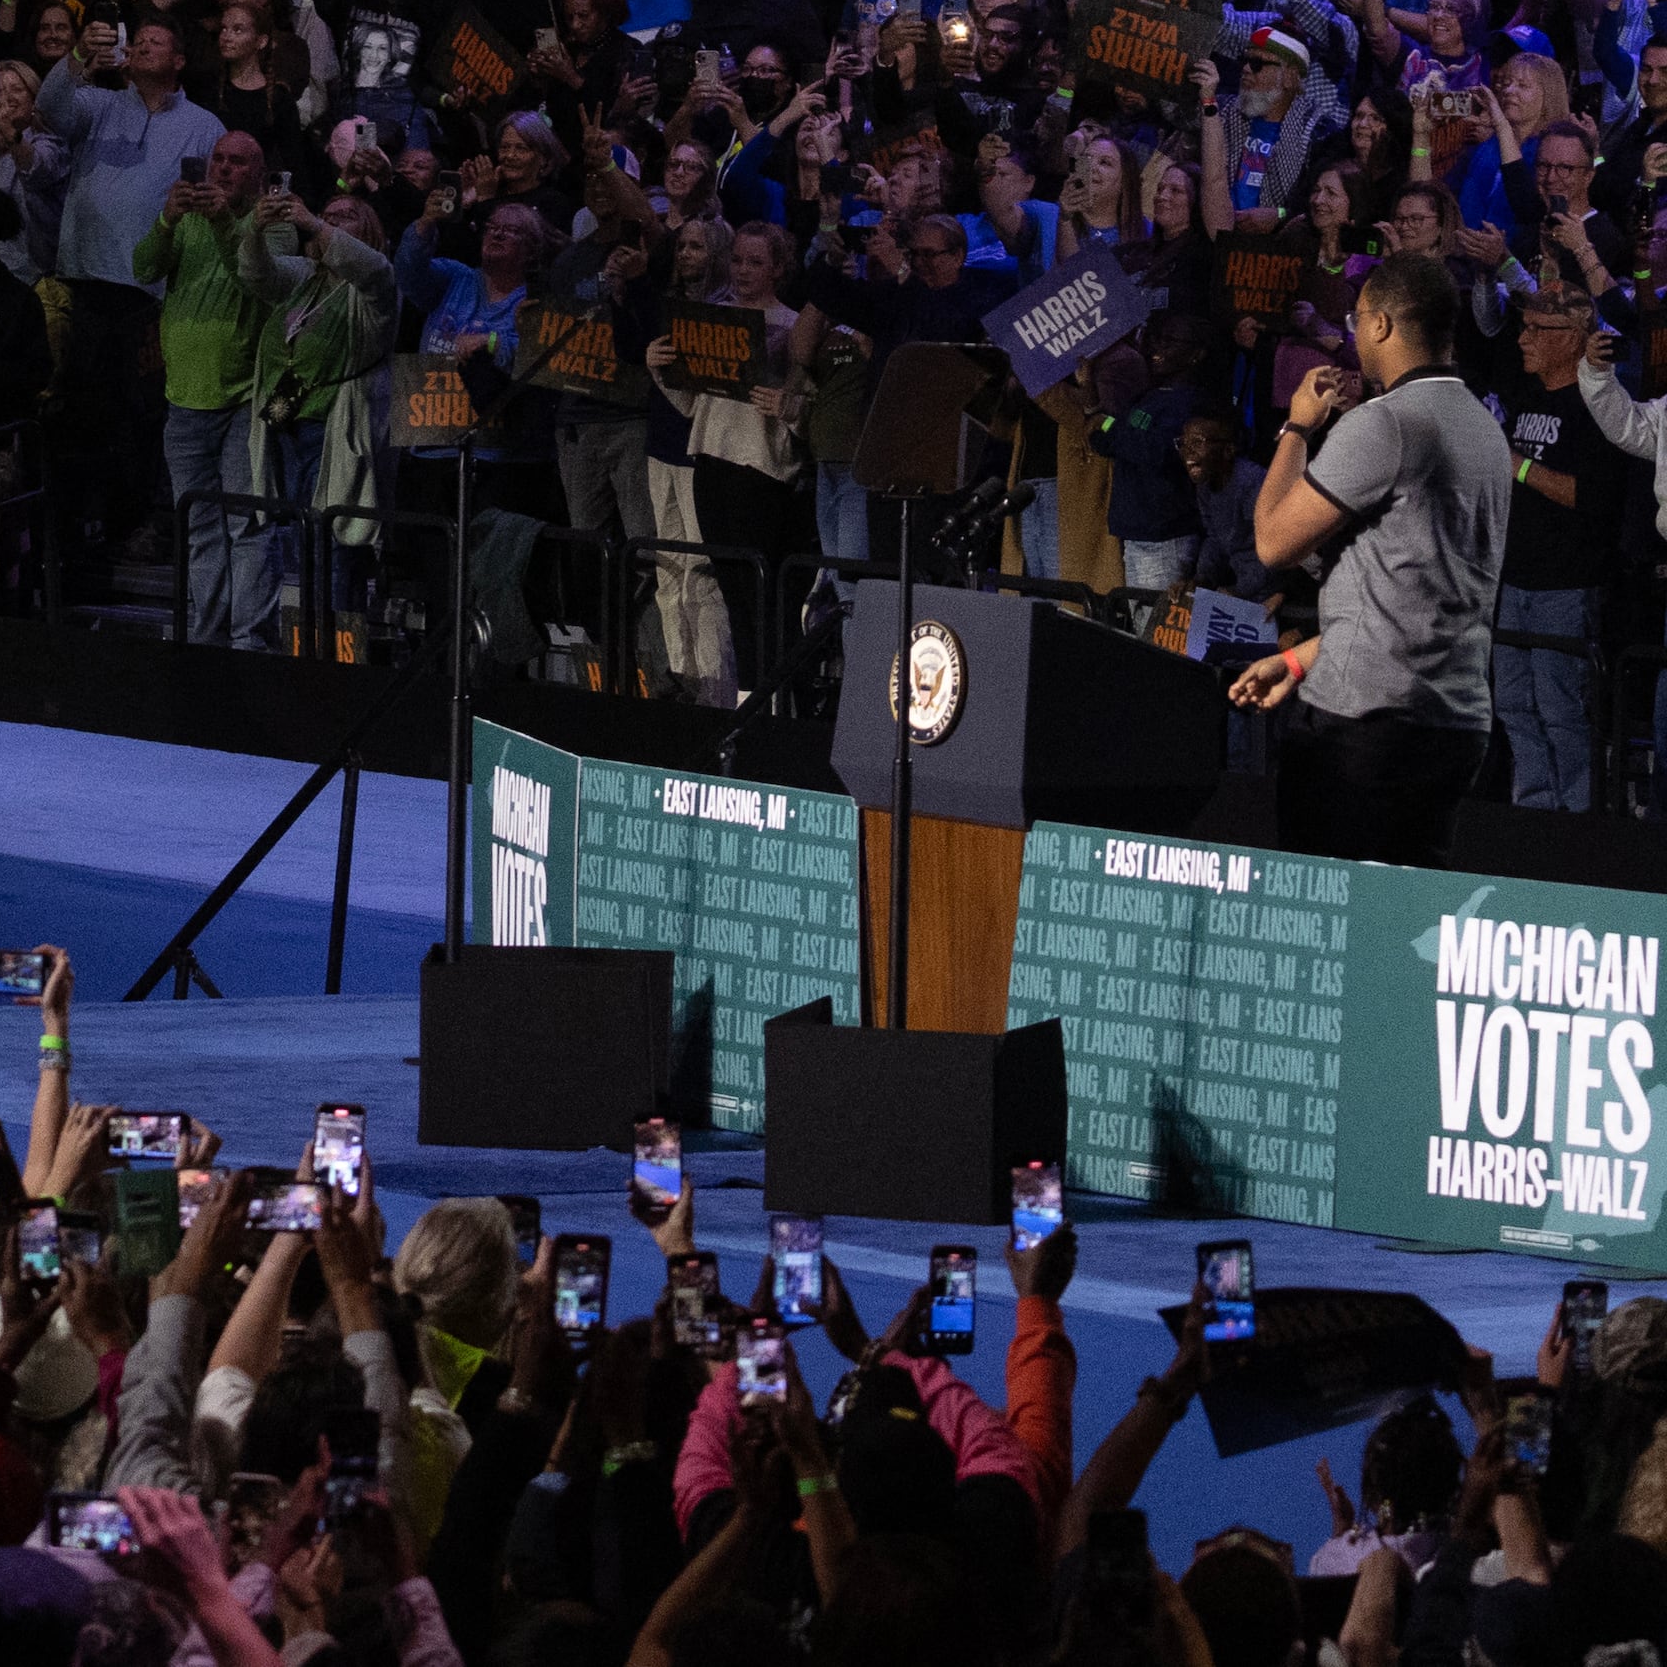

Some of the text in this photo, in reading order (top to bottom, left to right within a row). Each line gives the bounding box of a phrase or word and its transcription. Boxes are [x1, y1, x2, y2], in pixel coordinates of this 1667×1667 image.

[452, 22, 515, 94] HARRIS
[1089, 24, 1187, 85] HARRIS
[1111, 7, 1178, 45] WALZ
[1227, 251, 1303, 291] HARRIS
[670, 318, 752, 362] HARRIS
[1012, 270, 1107, 350] HARRIS
[1043, 306, 1108, 358] WALZ
[492, 765, 551, 858] MICHIGAN
[663, 777, 842, 838] EAST LANSING, MI EAST
[587, 812, 854, 887] MI EAST LANSING, MI EAST LANSING,
[1105, 838, 1305, 900] EAST LANSING, MI EAST
[492, 843, 548, 947] VOTES
[606, 859, 827, 925] LANSING, EAST LANSING, MI
[1019, 874, 1326, 954] MI EAST LANSING, MI EAST LANSING,
[657, 910, 828, 968] EAST LANSING, MI EAST
[1038, 924, 1296, 992] LANSING, MI EAST LANSING, MI
[1436, 914, 1659, 1016] MICHIGAN
[1060, 968, 1295, 1036] MI EAST LANSING, MI EAST
[1083, 1020, 1318, 1090] LANSING, MI EAST LANSING,
[1436, 999, 1654, 1154] VOTES
[1427, 1135, 1648, 1220] HARRIS-WALZ
